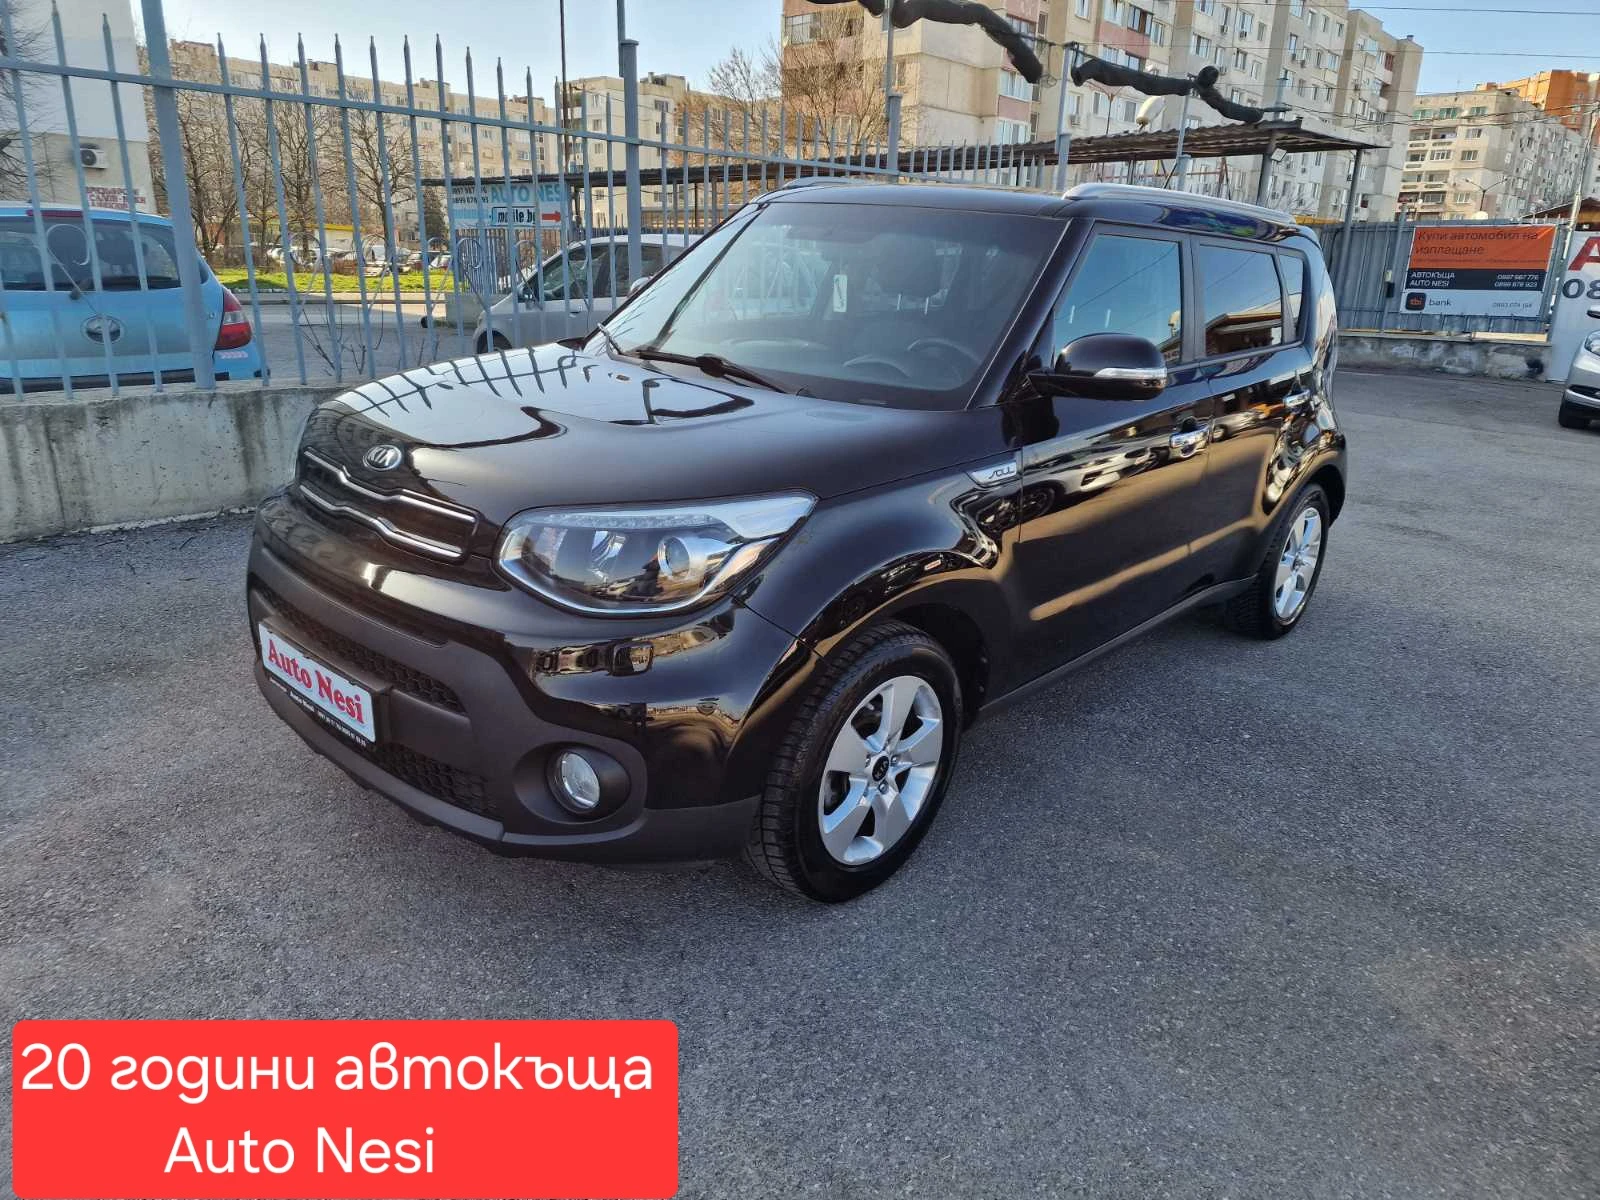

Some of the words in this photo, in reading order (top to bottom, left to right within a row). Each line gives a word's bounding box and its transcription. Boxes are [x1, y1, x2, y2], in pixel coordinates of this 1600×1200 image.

[491, 184, 530, 202] AUTO
[535, 183, 562, 202] NES
[1418, 231, 1449, 241] Купи
[1449, 230, 1519, 240] автомобил
[1520, 232, 1538, 240] на
[1415, 246, 1485, 256] изплащане
[1411, 271, 1456, 279] АВТОКЪЩА
[1410, 279, 1431, 287] AUTO
[1562, 278, 1600, 300] 08
[1429, 298, 1452, 306] bank
[268, 639, 313, 689] Auto
[315, 669, 365, 724] Nesi
